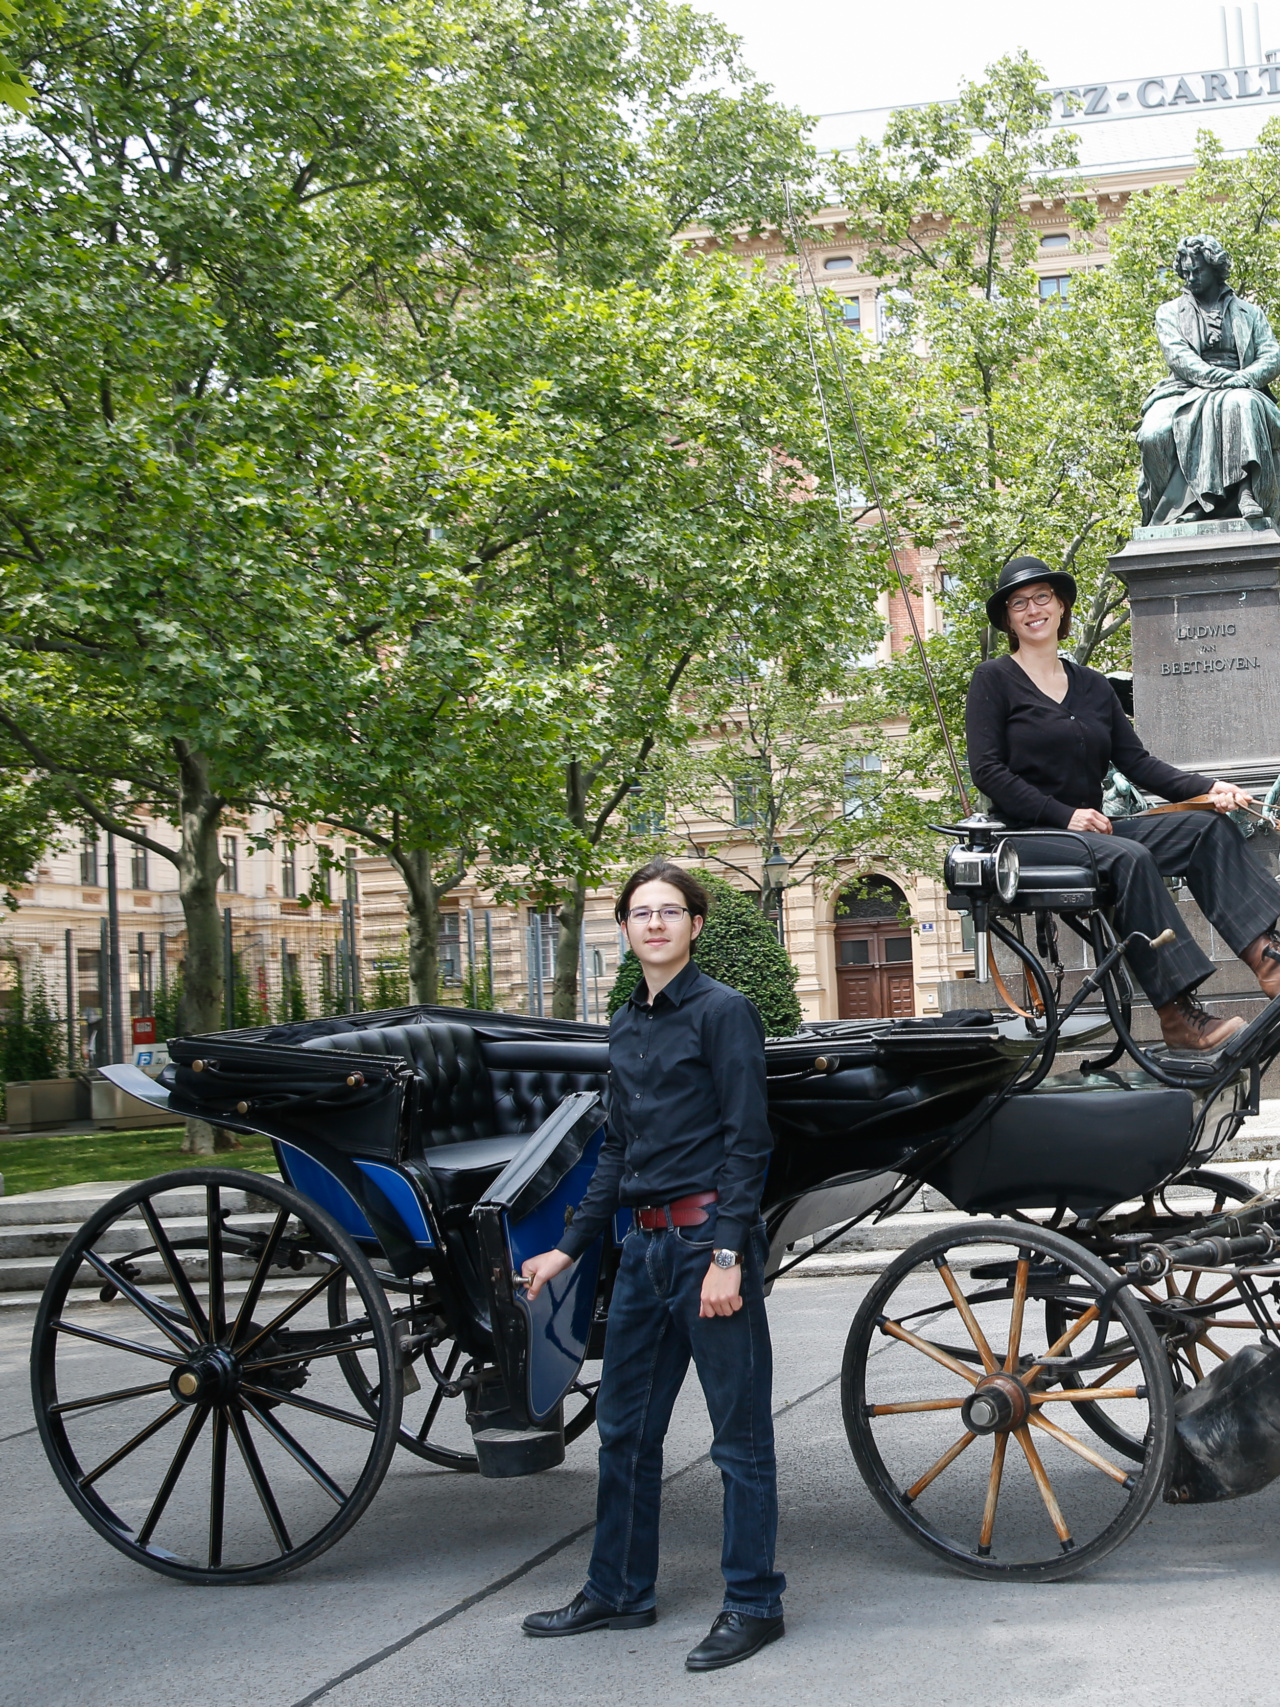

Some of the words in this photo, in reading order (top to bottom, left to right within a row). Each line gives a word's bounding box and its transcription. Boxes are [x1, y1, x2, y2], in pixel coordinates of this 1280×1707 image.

[1177, 623, 1236, 640] LUDWIG
[1200, 643, 1217, 654] VAN
[1160, 656, 1260, 676] BEETHOVEN.
